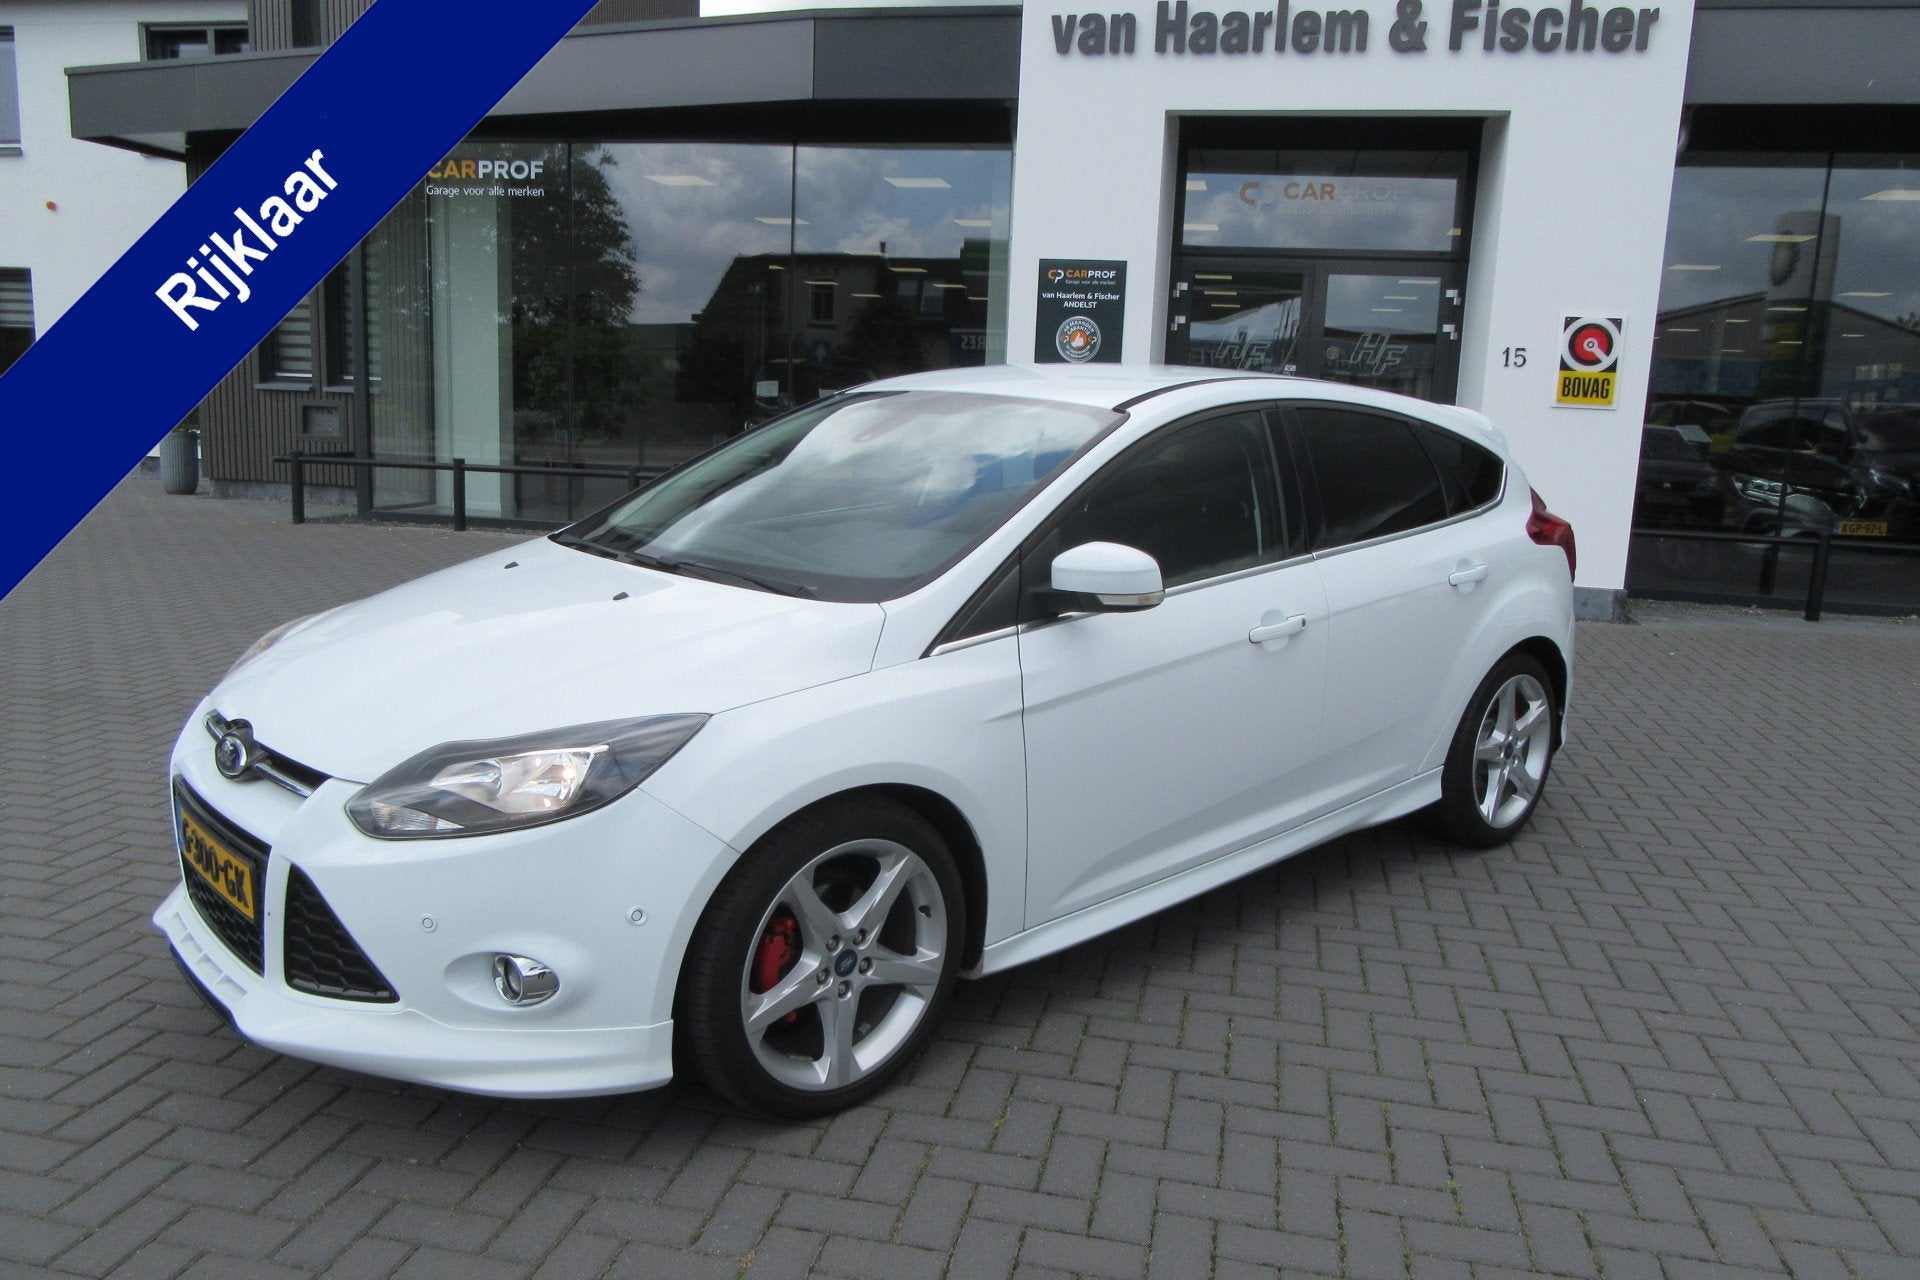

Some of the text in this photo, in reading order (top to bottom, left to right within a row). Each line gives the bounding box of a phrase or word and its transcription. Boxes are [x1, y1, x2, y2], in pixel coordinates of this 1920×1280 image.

[1051, 0, 1660, 54] van Haarlem & Fischer
[427, 159, 544, 180] CARPROF
[426, 185, 545, 198] Garage voor alle merken
[1066, 269, 1116, 279] CARPROF
[1087, 292, 1093, 300] &
[1094, 292, 1119, 300] Fischer
[1502, 347, 1527, 368] 15
[1561, 376, 1611, 399] BOVAG
